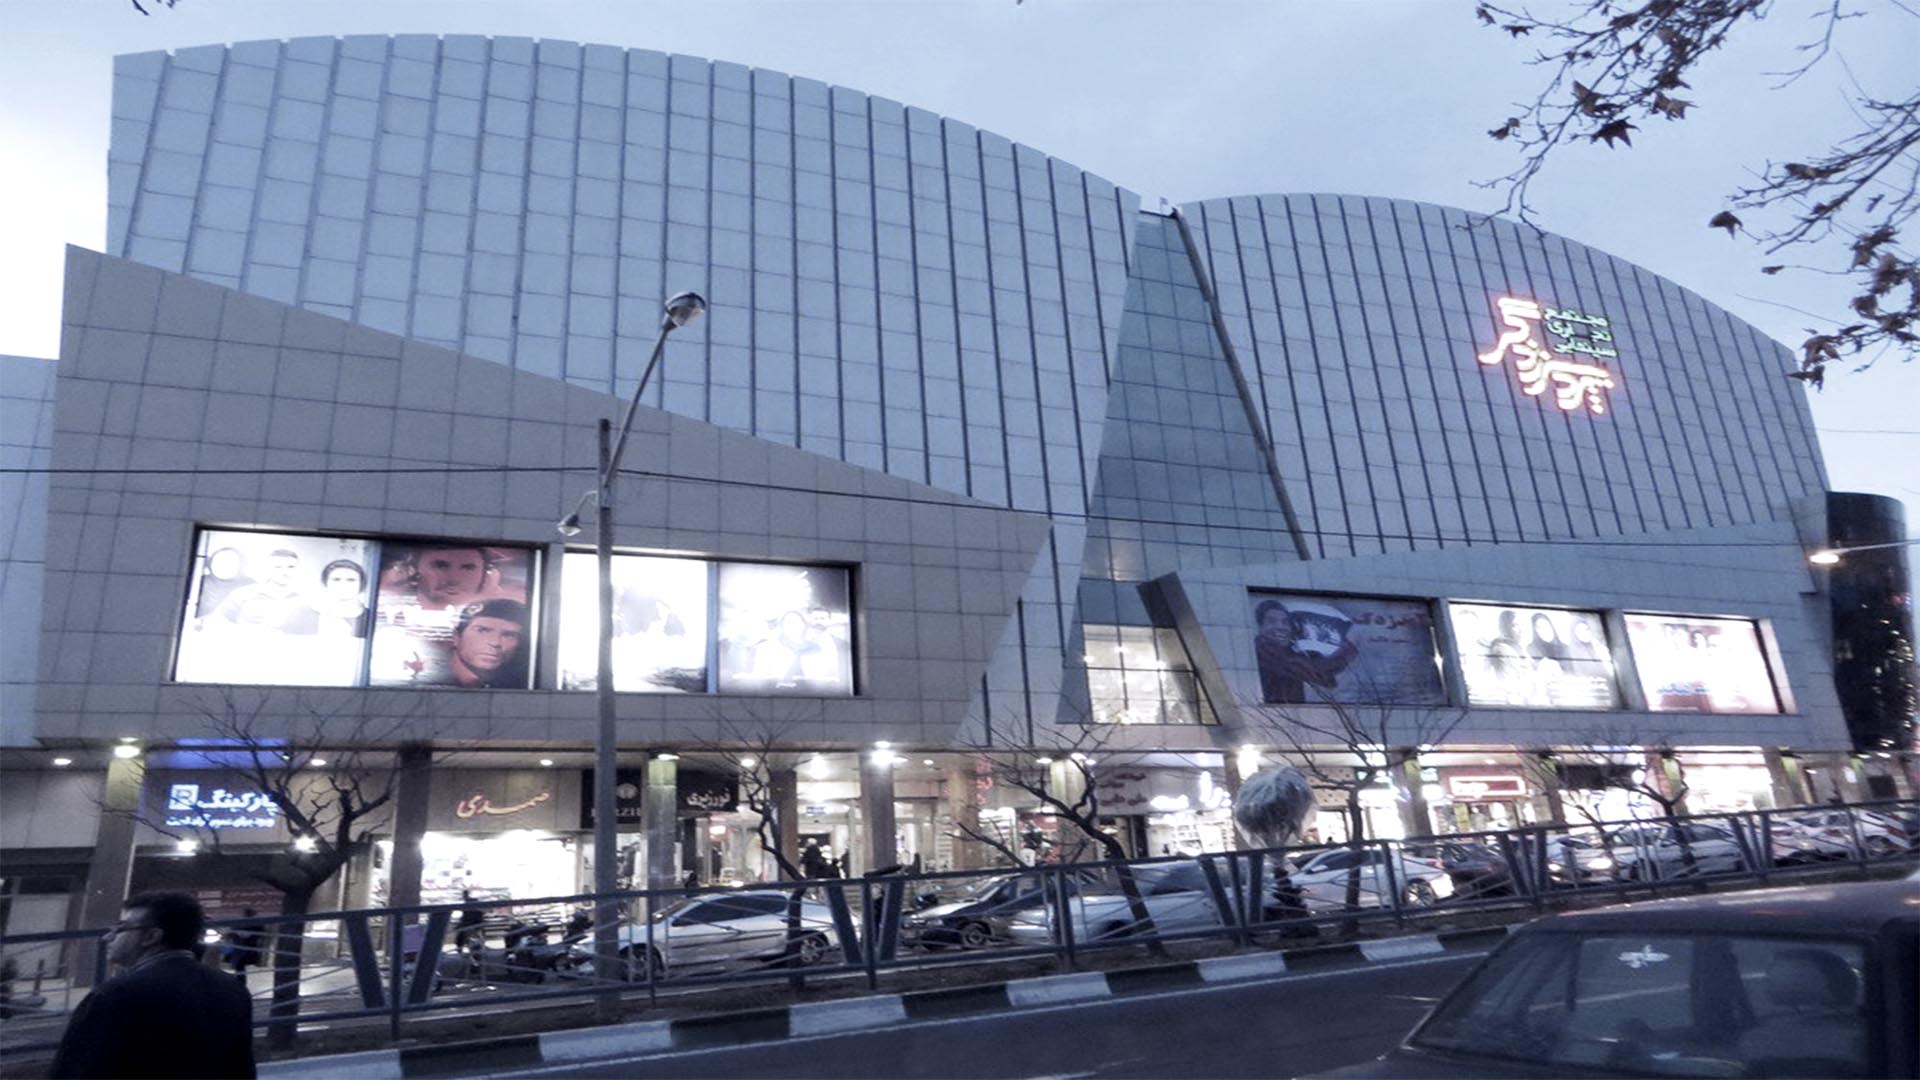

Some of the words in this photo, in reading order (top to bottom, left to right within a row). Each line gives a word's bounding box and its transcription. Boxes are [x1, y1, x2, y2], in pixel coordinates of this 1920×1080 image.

[1545, 308, 1608, 327] مجتمع
[197, 789, 279, 816] پارکینگ
[456, 792, 550, 818] صمدی
